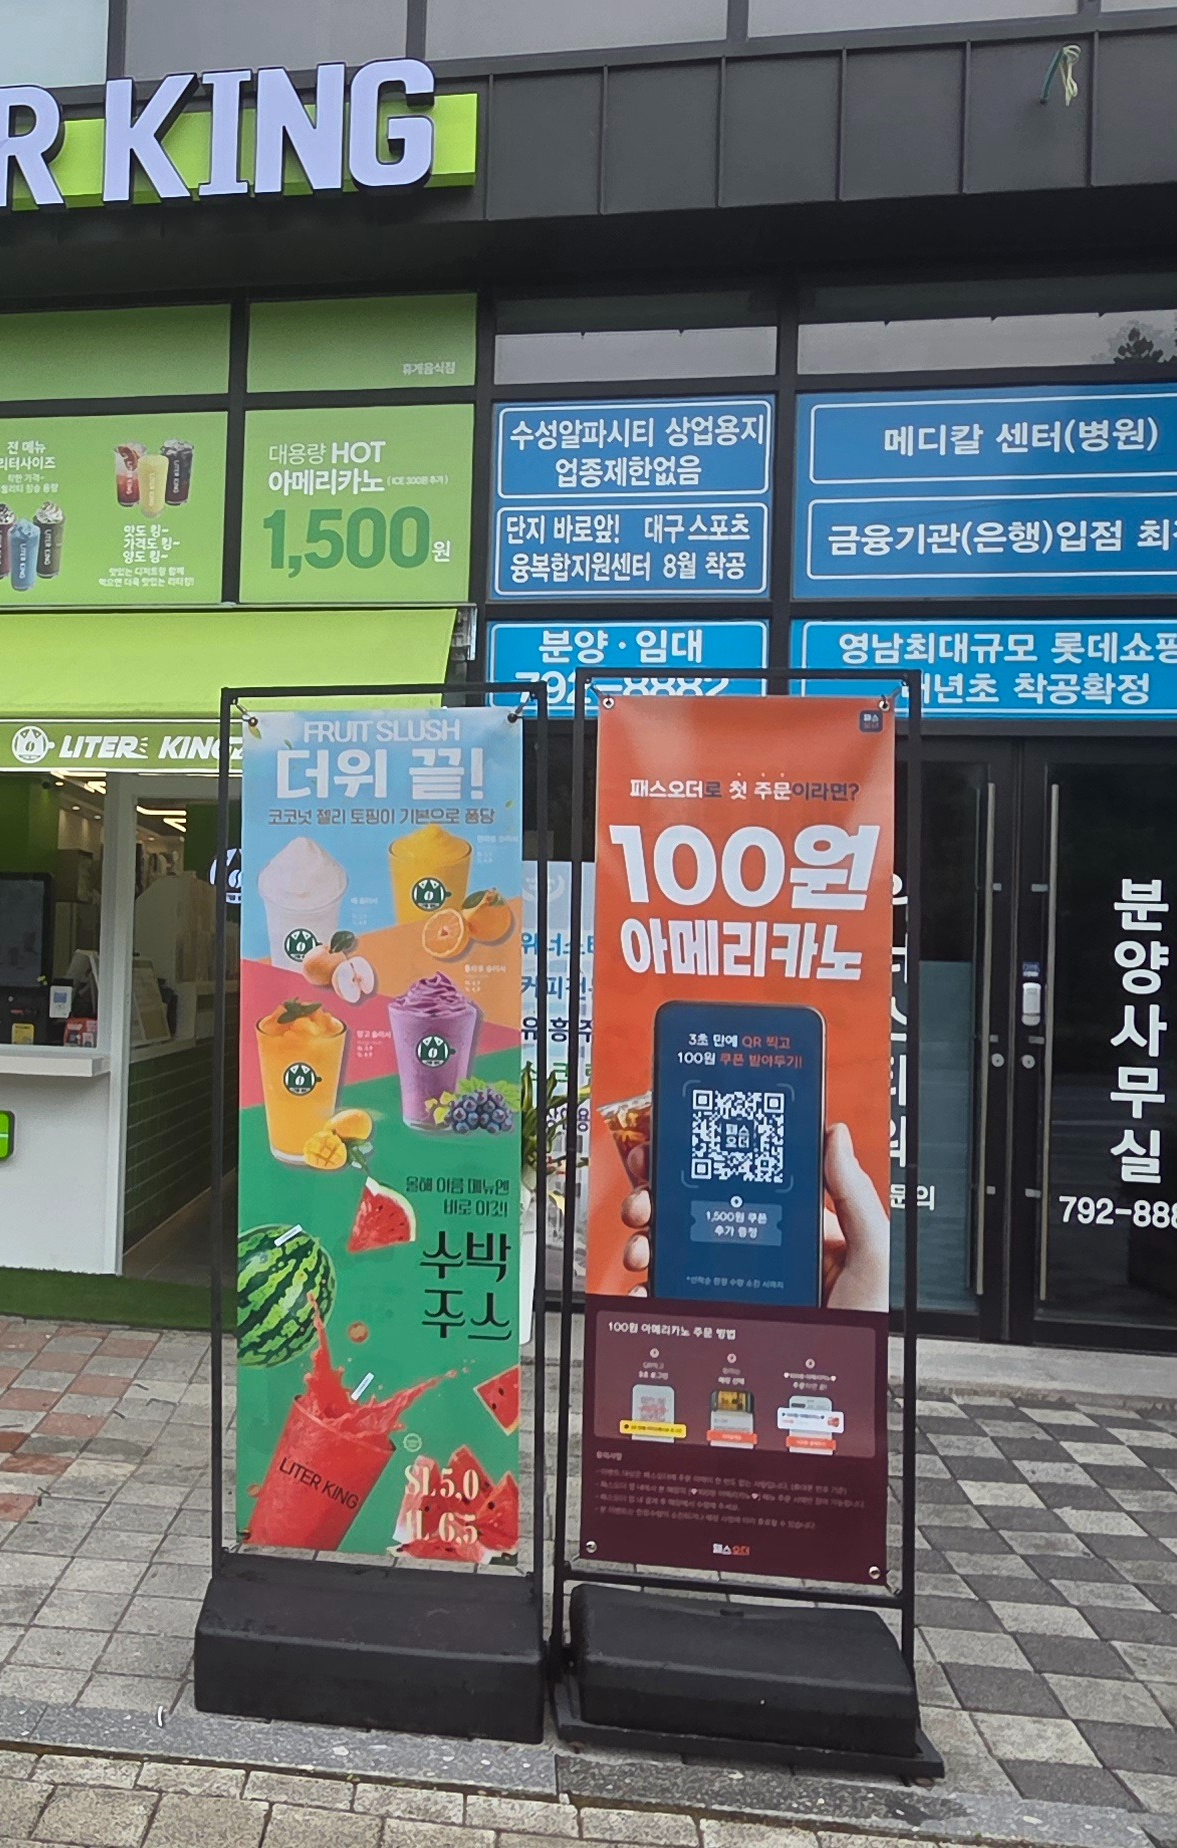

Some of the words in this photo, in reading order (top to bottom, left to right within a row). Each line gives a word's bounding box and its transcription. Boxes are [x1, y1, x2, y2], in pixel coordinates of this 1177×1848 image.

[103, 58, 435, 200] KING
[7, 441, 18, 454] 전
[22, 440, 46, 454] 메뉴
[510, 417, 654, 450] 수성알파시티
[665, 414, 764, 447] 상업용지
[884, 423, 983, 457] 메디칼
[996, 417, 1159, 453] 센터(병원)
[269, 442, 326, 465] 대용량
[331, 441, 386, 464] HOT
[268, 468, 385, 496] 아메리카노
[555, 454, 702, 488] 업종제한없음
[263, 506, 450, 578] 1,500원
[506, 514, 546, 544] 단지
[553, 514, 620, 544] 바로앞!
[828, 520, 1123, 556] 금융기관(은행)입점
[1137, 519, 1177, 551] 최
[510, 551, 651, 583] 융복합지원센터
[662, 552, 696, 580] 8월
[704, 551, 746, 580] 착공
[839, 632, 1038, 664] 영남최대규모
[1014, 672, 1150, 705] 착공확정
[303, 720, 372, 743] FRUIT
[376, 718, 460, 742] SLUSH
[59, 735, 148, 759] LITER
[276, 749, 387, 799] 더위
[409, 747, 484, 800] 끝!
[630, 780, 722, 799] 패스오더로
[729, 780, 748, 800] 첫
[754, 781, 860, 801] 주문이라면?
[268, 808, 312, 826] 코코넛
[316, 808, 346, 825] 젤리
[351, 808, 395, 824] 토핑이
[399, 807, 460, 825] 기본으로
[609, 824, 880, 910] 100원
[620, 918, 862, 980] 아메리카노
[688, 1033, 708, 1046] 3초
[713, 1034, 738, 1048] 만에
[742, 1036, 762, 1048] QR
[677, 1052, 716, 1065] 100원
[420, 1230, 512, 1282] 수박
[421, 1288, 512, 1341] 주스
[608, 1321, 638, 1334] 100원
[641, 1324, 690, 1337] 아메리카노
[279, 1457, 323, 1489] LITER
[322, 1482, 360, 1510] KING
